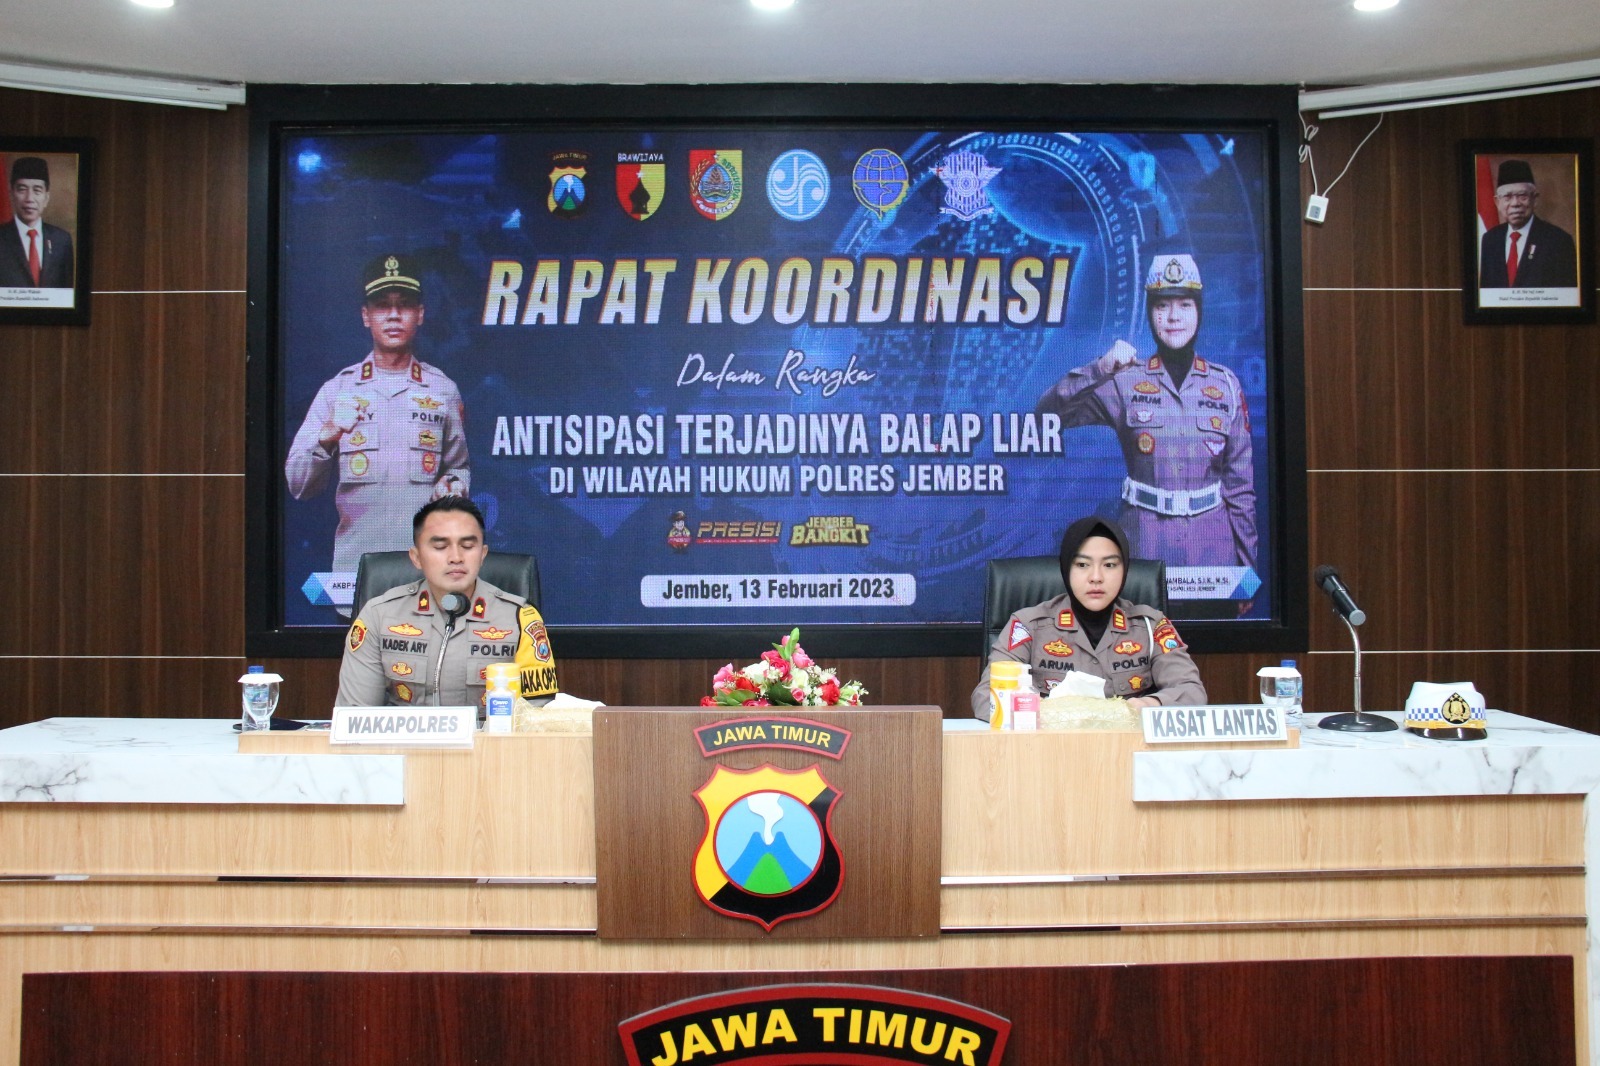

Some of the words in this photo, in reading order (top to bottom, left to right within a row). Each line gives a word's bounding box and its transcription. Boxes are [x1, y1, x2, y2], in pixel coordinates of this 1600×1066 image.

[617, 153, 664, 162] BRAWIJAYA
[481, 258, 678, 325] RAPAT
[686, 257, 1071, 325] KOORDINASI
[676, 353, 766, 389] Dalam
[775, 350, 876, 396] Rangka
[1131, 395, 1161, 404] ARUM
[1198, 400, 1229, 412] POLRI
[491, 415, 665, 456] ANTISIPASI
[677, 414, 869, 455] TERJADINYA
[880, 414, 980, 454] BALAP
[992, 413, 1062, 453] LIAR
[550, 467, 574, 494] DI
[583, 466, 691, 494] WILAYAH
[701, 466, 791, 493] HUKUM
[801, 465, 894, 492] POLRES
[903, 465, 1005, 492] JEMBER
[697, 522, 782, 538] PRESISI
[806, 516, 855, 527] JEMBER
[790, 523, 870, 545] BANGKIT
[662, 580, 732, 602] Jember,
[739, 579, 763, 599] 13
[768, 579, 842, 599] Februari
[849, 578, 895, 598] 2023
[382, 638, 409, 653] KADEK
[410, 641, 427, 654] ARY
[470, 644, 515, 657] POLRI
[1038, 659, 1075, 671] ARUM
[1112, 655, 1149, 671] POLRI
[348, 715, 458, 734] WAKAPOLRES
[1151, 709, 1207, 737] KASAT
[1211, 708, 1278, 736] LANTAS
[713, 725, 767, 746] JAWA
[771, 724, 832, 748] TIMUR
[651, 1008, 798, 1066] JAWA
[812, 1007, 981, 1066] TIMUR
